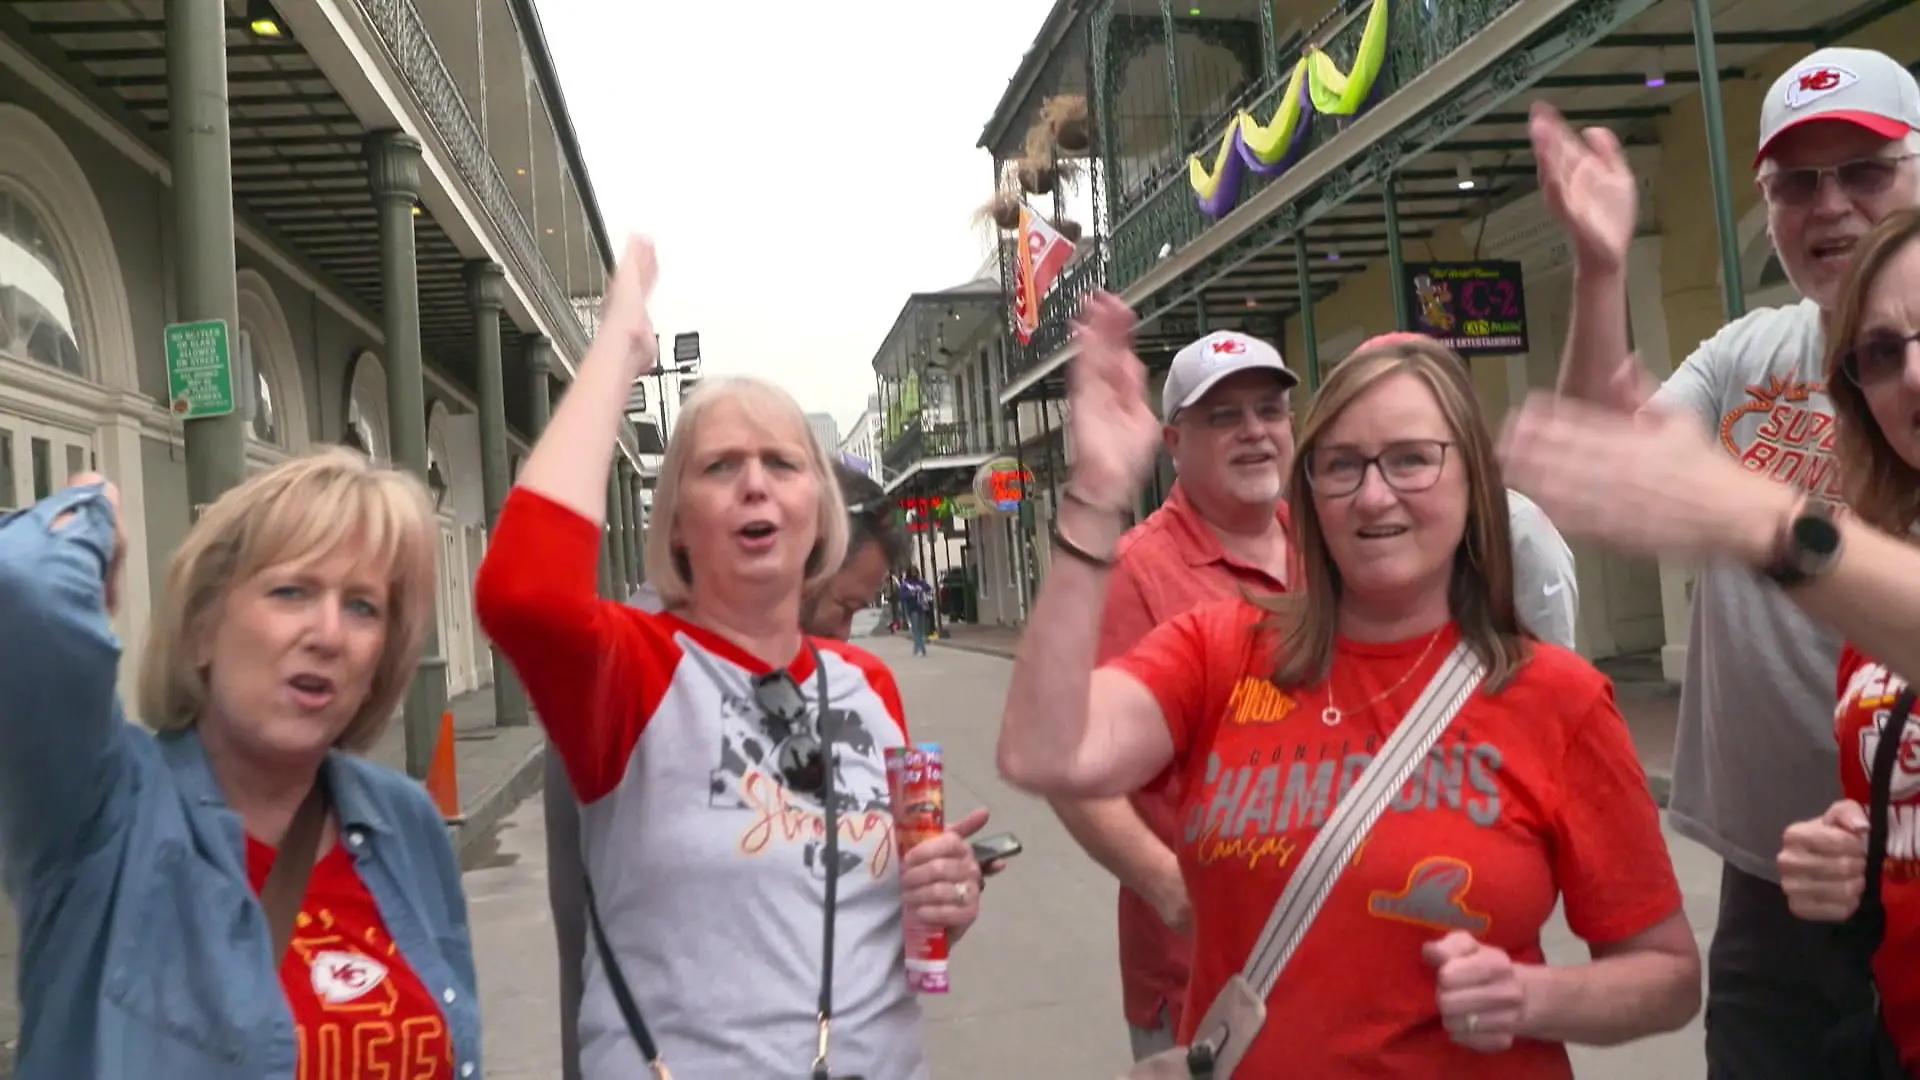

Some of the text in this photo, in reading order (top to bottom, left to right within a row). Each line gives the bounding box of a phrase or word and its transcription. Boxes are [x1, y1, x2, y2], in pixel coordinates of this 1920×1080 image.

[737, 770, 894, 880] Strong
[1184, 740, 1503, 844] CHAMPONS
[329, 961, 369, 989] KC
